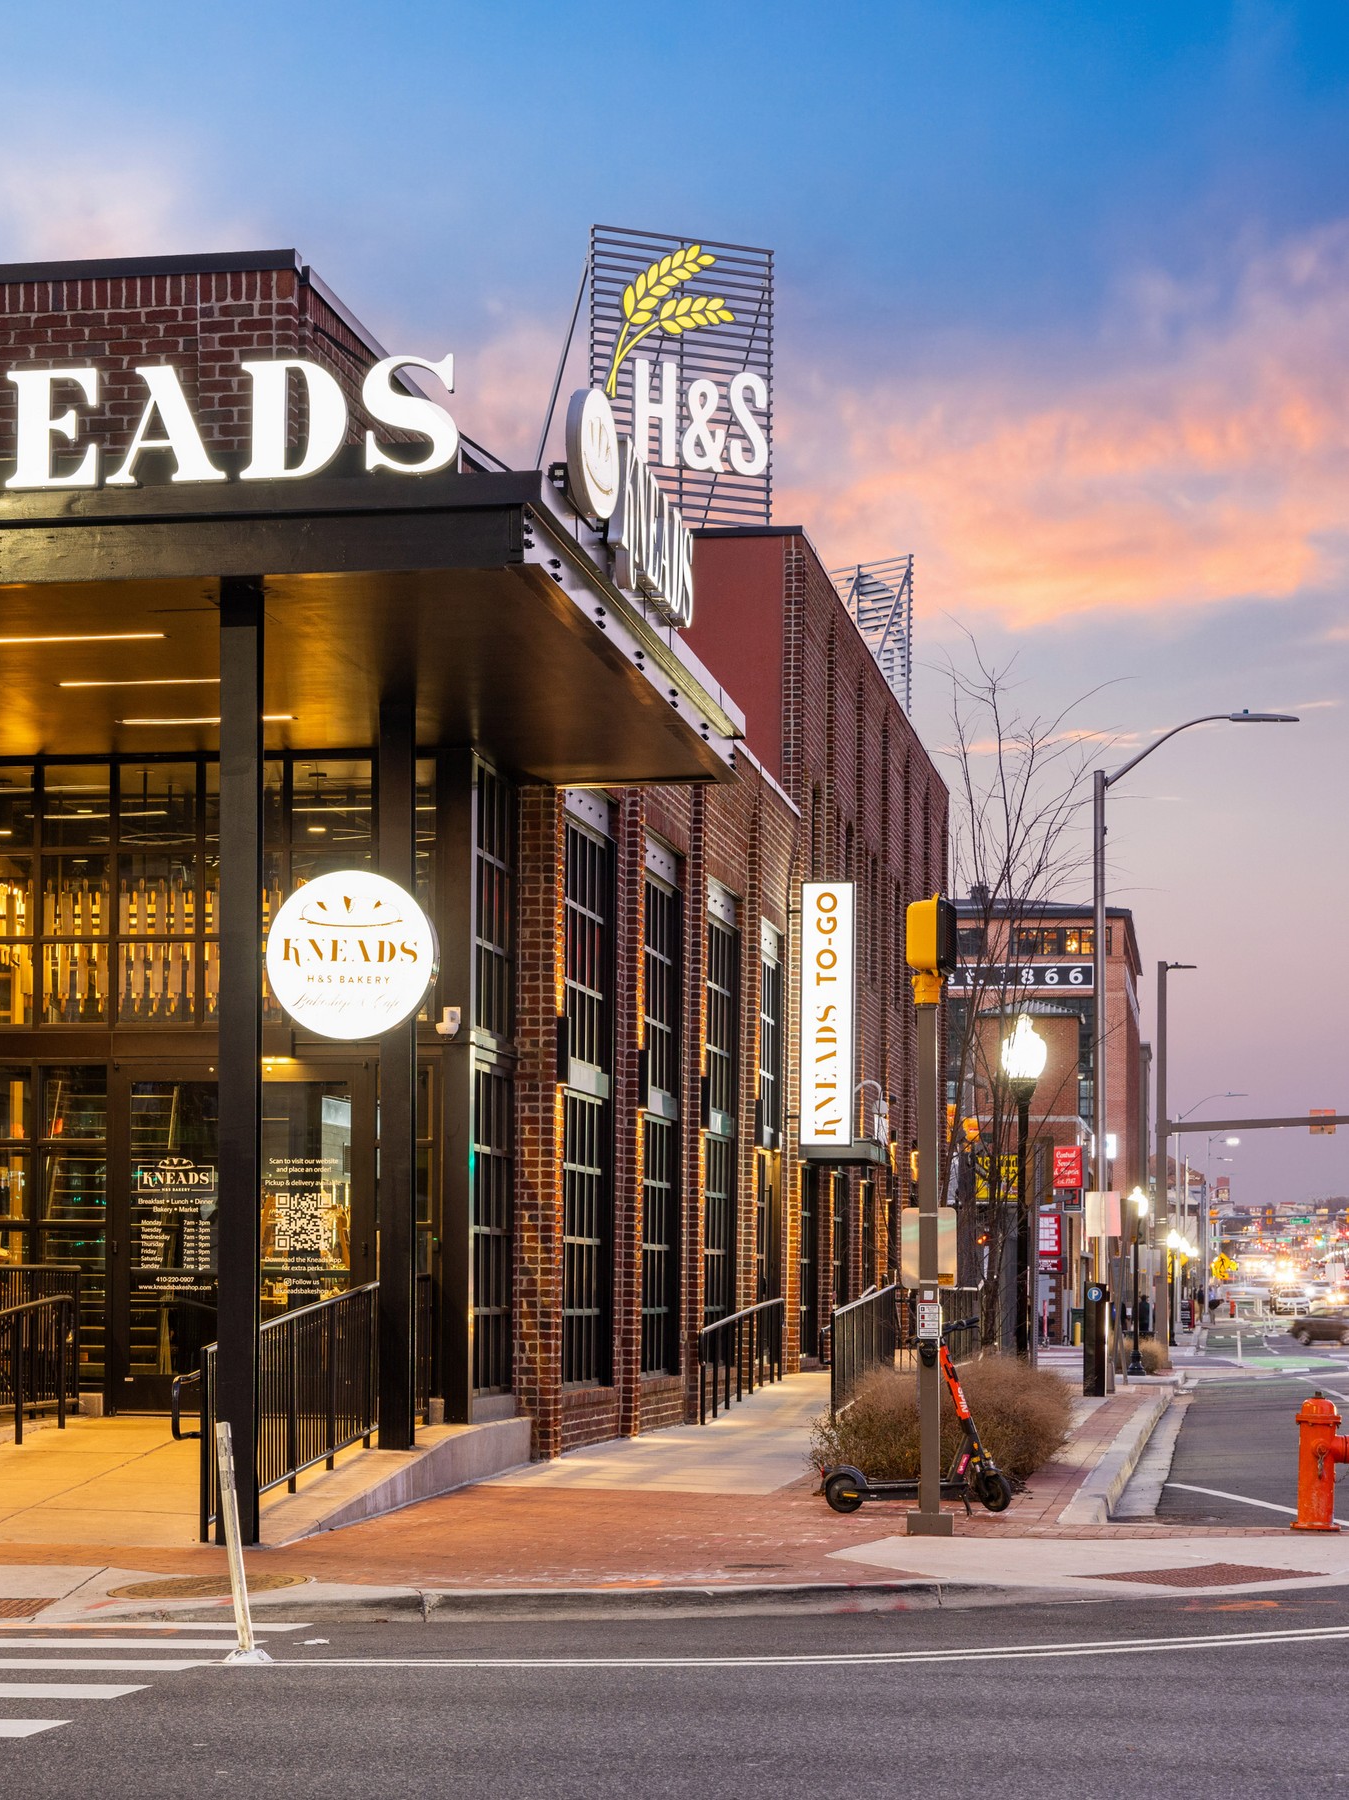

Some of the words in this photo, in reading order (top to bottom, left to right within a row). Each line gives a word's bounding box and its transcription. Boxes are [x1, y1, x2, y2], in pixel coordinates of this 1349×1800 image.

[633, 358, 769, 476] H&S
[621, 434, 694, 628] KNEADS
[282, 937, 419, 968] KNEADS
[815, 891, 838, 987] TO-GO
[307, 974, 333, 984] H&S
[339, 975, 391, 985] BAKERY
[814, 1004, 843, 1136] KNEADS
[142, 1172, 210, 1187] KNEADS
[957, 1386, 969, 1413] SPIN
